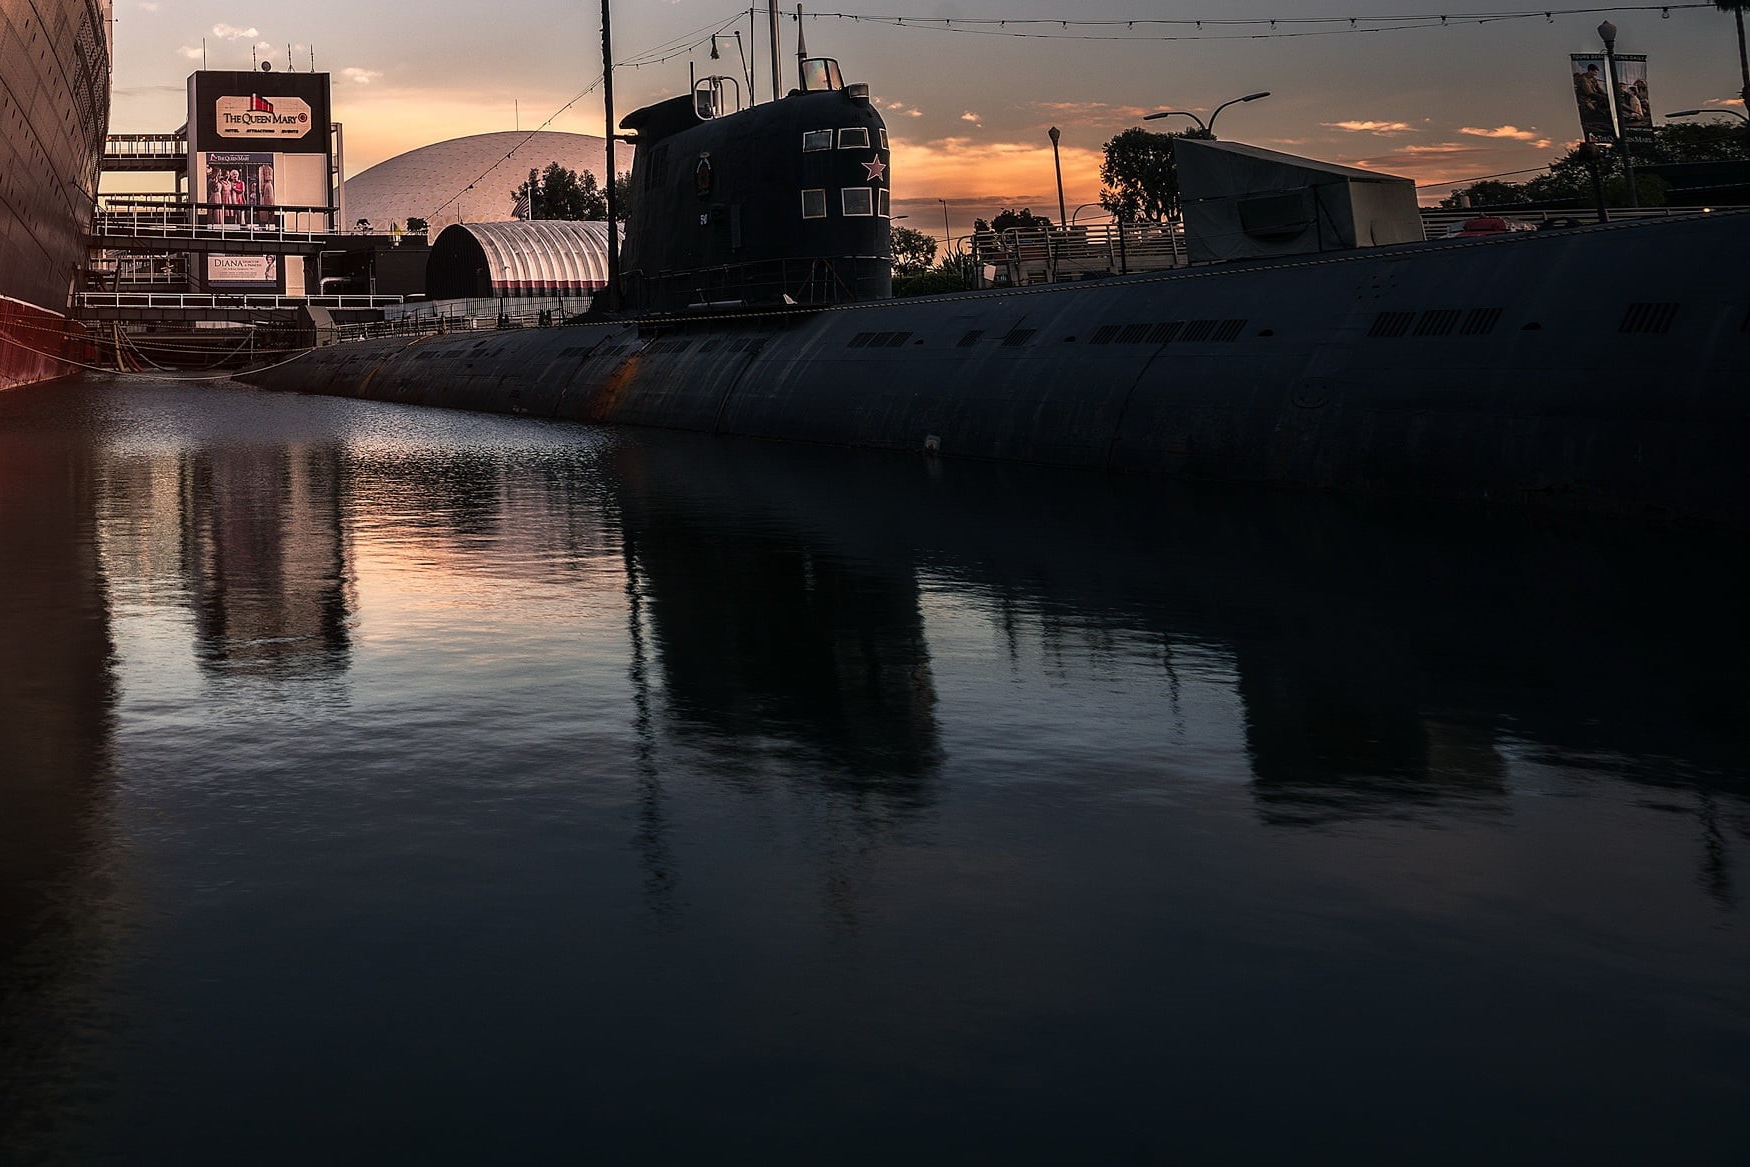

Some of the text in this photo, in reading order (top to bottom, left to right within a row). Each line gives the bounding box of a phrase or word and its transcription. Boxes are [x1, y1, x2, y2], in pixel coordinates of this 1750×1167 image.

[223, 113, 298, 125] THE QUEEN MARY
[214, 258, 243, 267] DIANA
